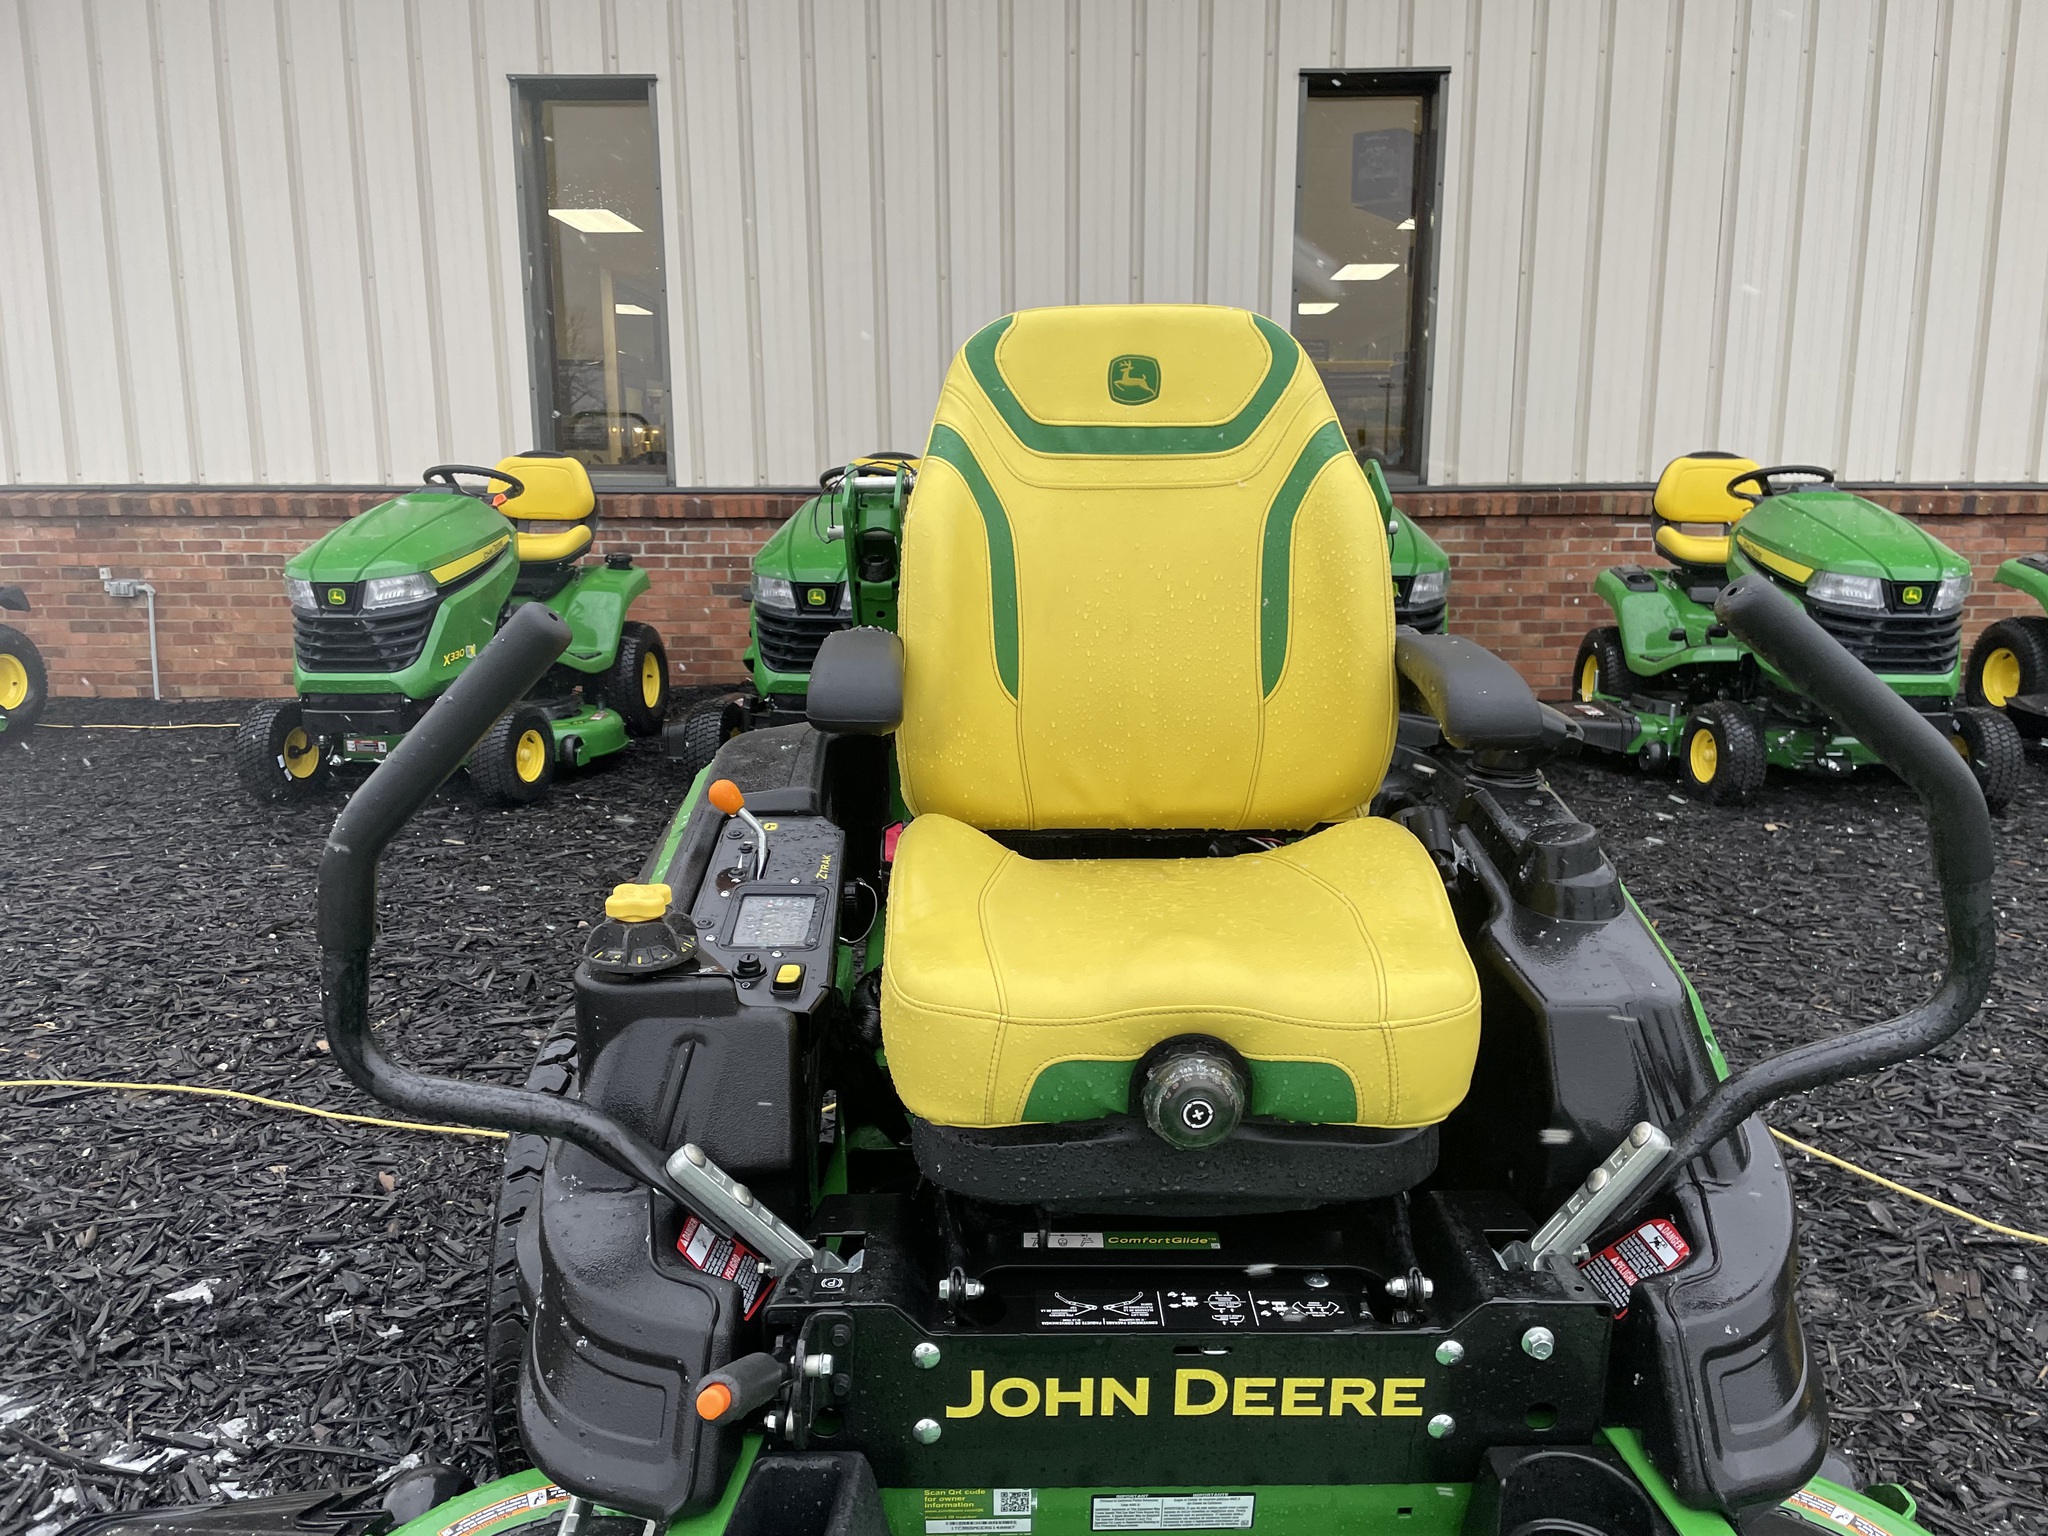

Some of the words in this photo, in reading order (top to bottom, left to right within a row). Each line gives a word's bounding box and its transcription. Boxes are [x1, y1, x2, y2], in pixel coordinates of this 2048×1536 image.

[443, 648, 465, 667] X330
[816, 854, 831, 880] ZTRAK
[681, 1218, 698, 1240] DANGER
[1662, 1226, 1685, 1251] DANGER
[725, 1253, 740, 1280] PELIGRO
[1614, 1257, 1638, 1287] PELIGRO
[946, 1370, 1149, 1418] JOHN
[1174, 1368, 1425, 1416] DEERE
